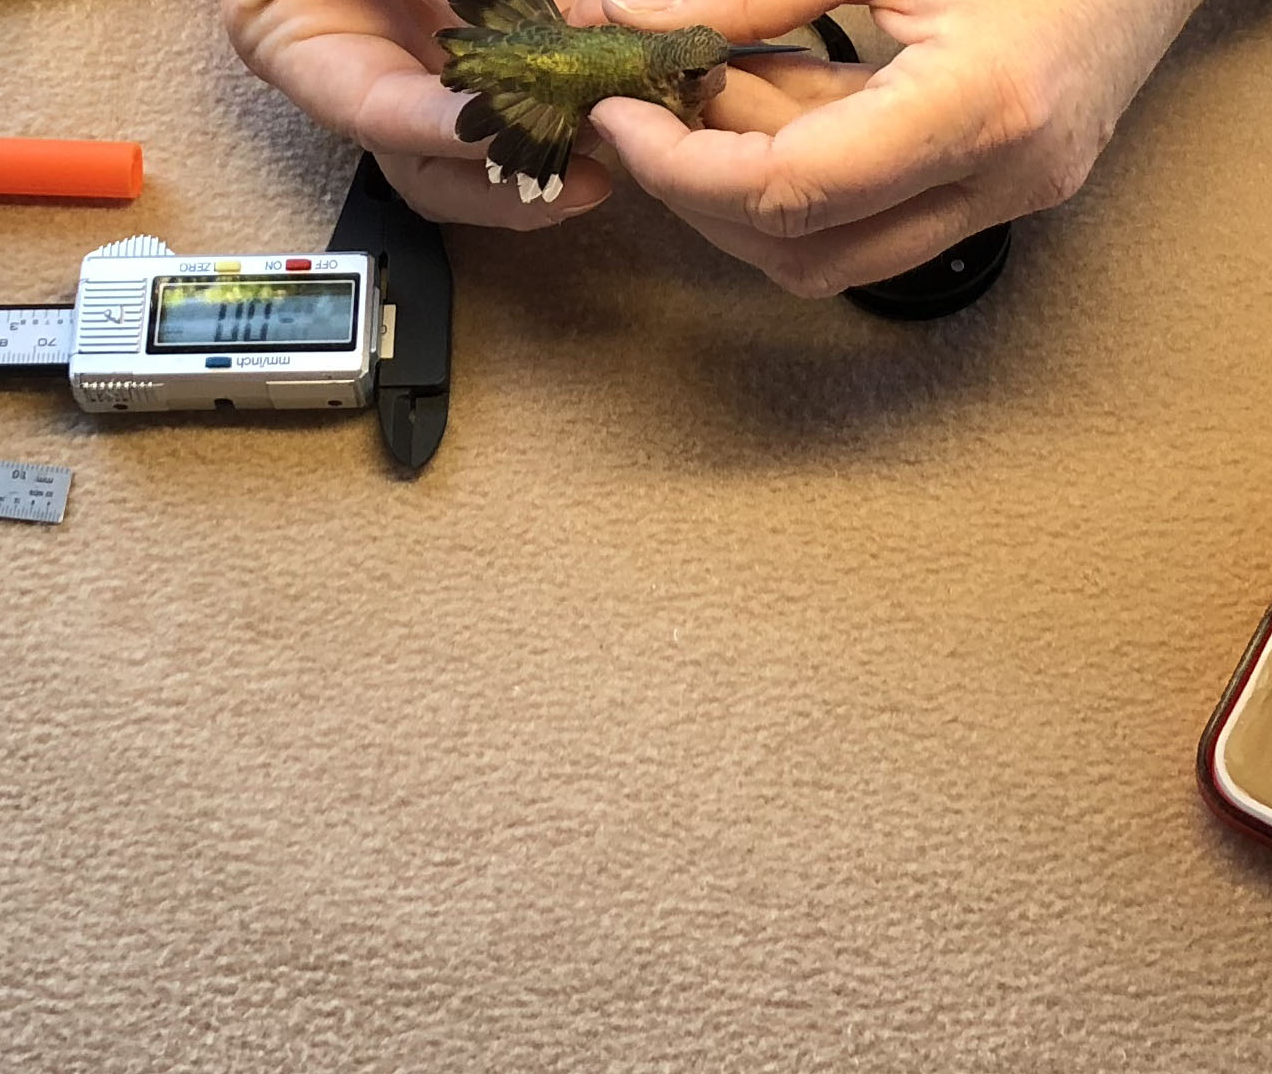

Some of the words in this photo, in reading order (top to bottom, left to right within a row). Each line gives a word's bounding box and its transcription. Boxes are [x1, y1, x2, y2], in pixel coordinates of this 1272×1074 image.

[180, 261, 211, 272] ZERO
[265, 260, 282, 270] ON
[315, 259, 338, 270] OFF
[9, 322, 20, 331] 3
[37, 337, 57, 347] 70
[236, 355, 290, 369] mm/inch
[12, 469, 27, 480] 10
